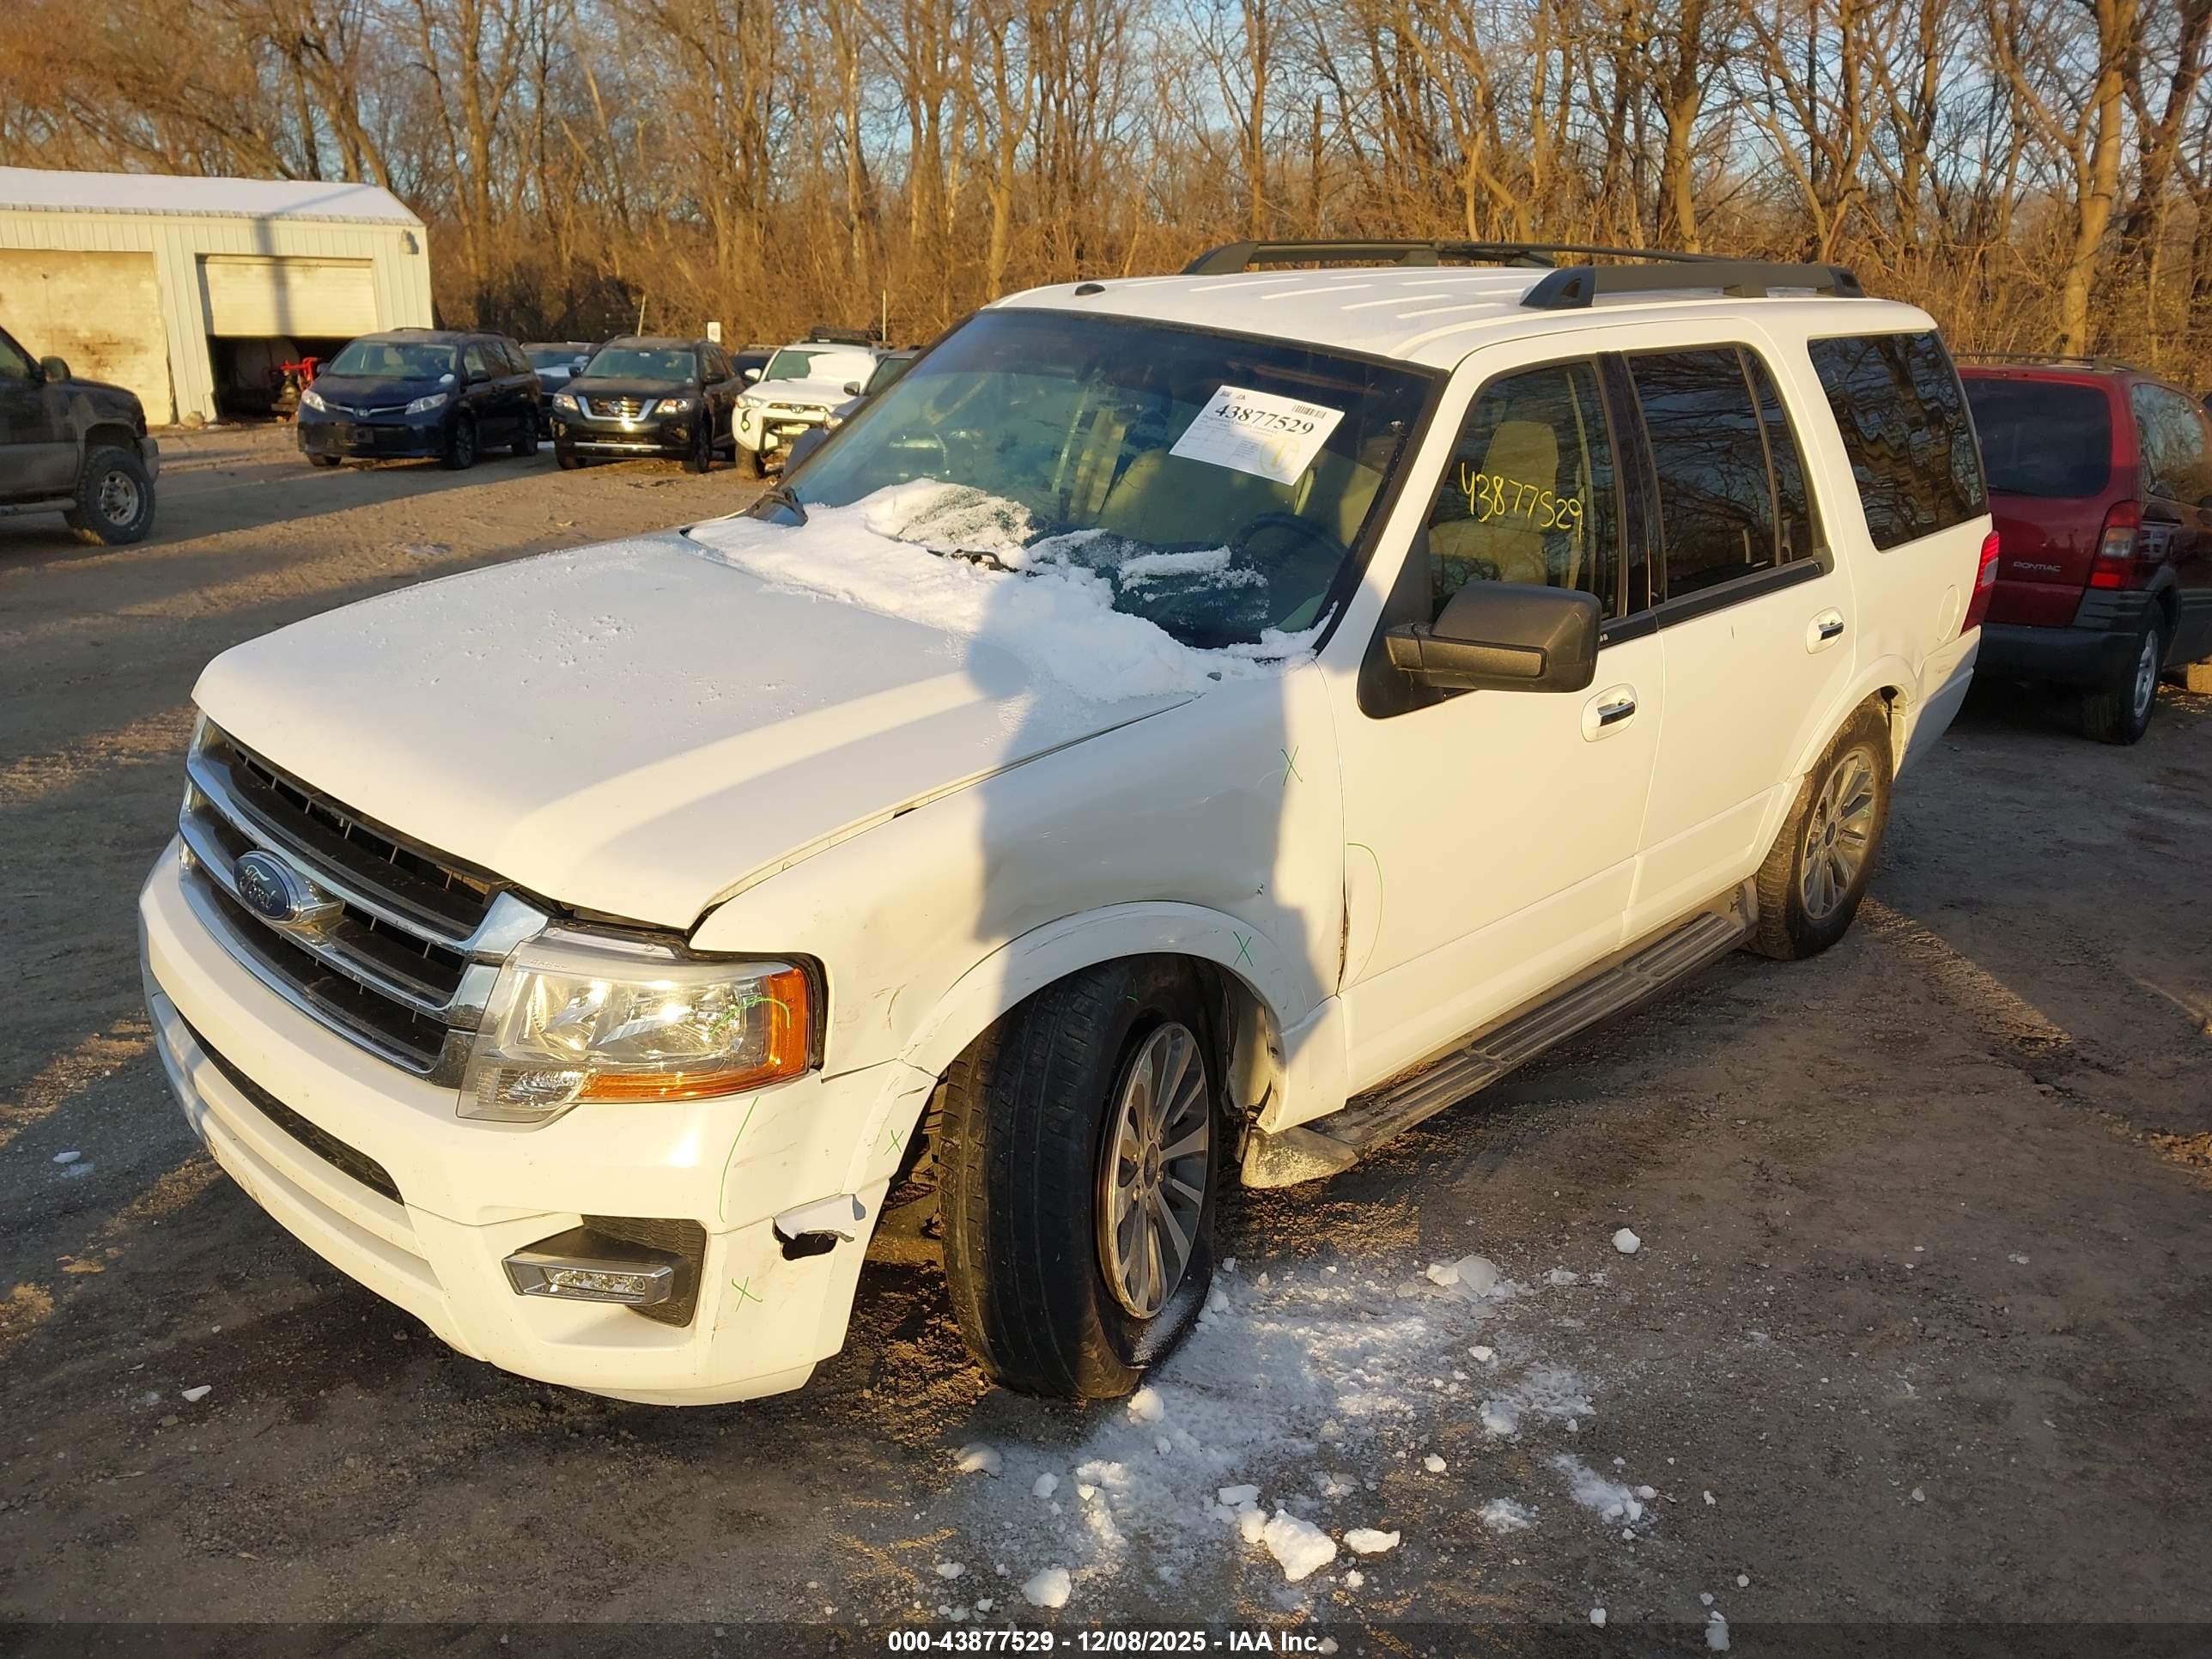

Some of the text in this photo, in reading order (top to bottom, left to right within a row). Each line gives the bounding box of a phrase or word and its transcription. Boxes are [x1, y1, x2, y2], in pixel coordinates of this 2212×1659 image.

[1214, 404, 1315, 435] 43877529
[1462, 462, 1583, 543] 43877529
[2013, 562, 2061, 572] PONTIAC
[240, 864, 276, 910] Ford
